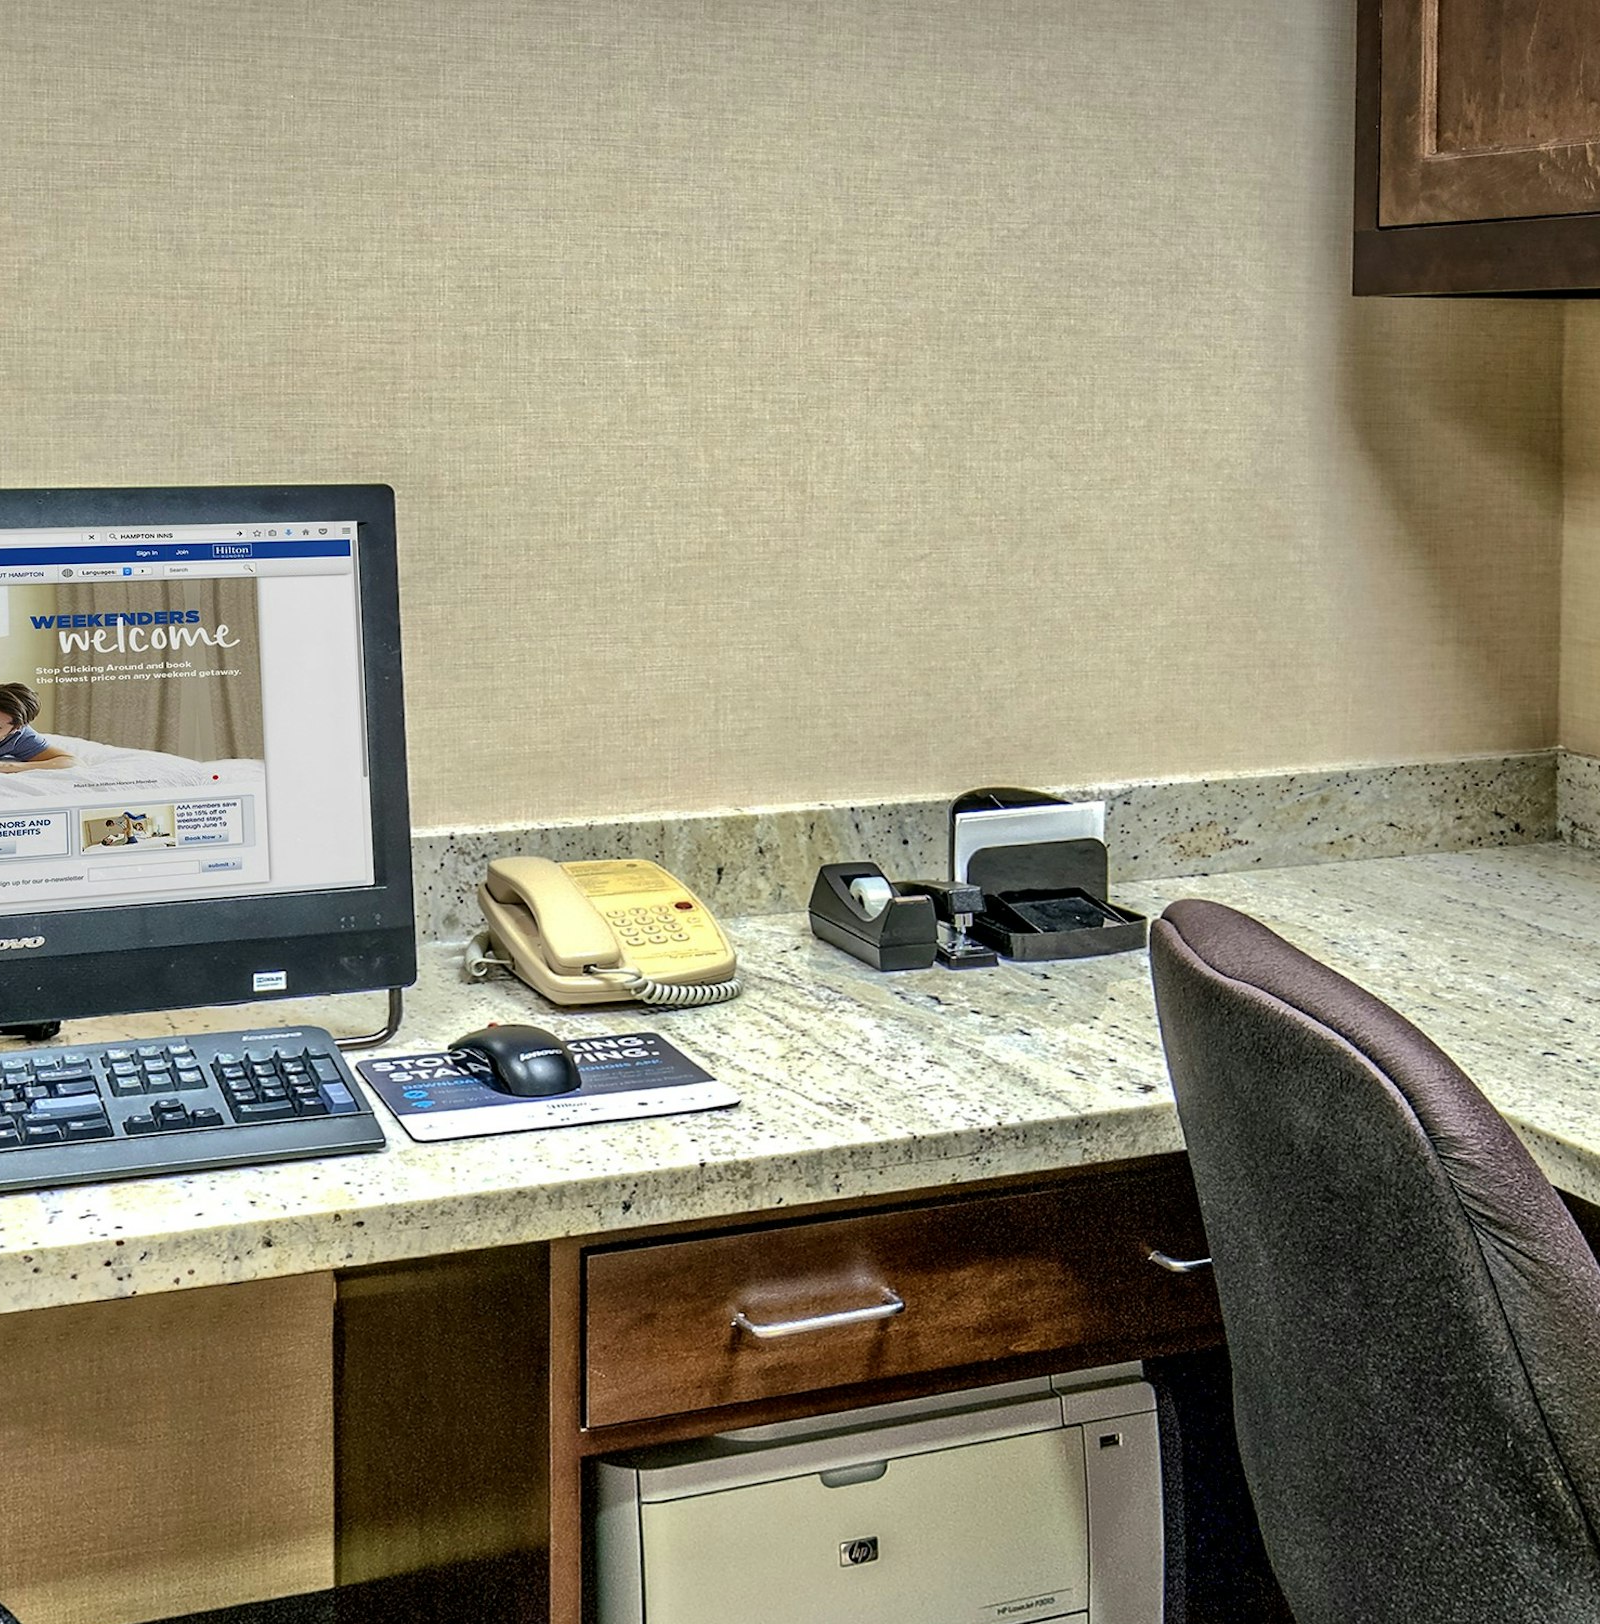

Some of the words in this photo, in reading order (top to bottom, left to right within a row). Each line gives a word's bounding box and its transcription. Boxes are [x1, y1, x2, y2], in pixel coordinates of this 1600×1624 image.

[215, 545, 249, 554] Hilton
[30, 610, 199, 629] WEEKENDERS
[59, 617, 241, 653] welcome
[36, 667, 60, 675] Stop
[62, 665, 104, 674] Clicking
[166, 661, 192, 669] book
[55, 675, 88, 683] lowest
[90, 674, 116, 683] price
[133, 673, 151, 681] any
[153, 670, 197, 679] weekend
[199, 668, 241, 679] getaway.
[28, 819, 51, 828] AND
